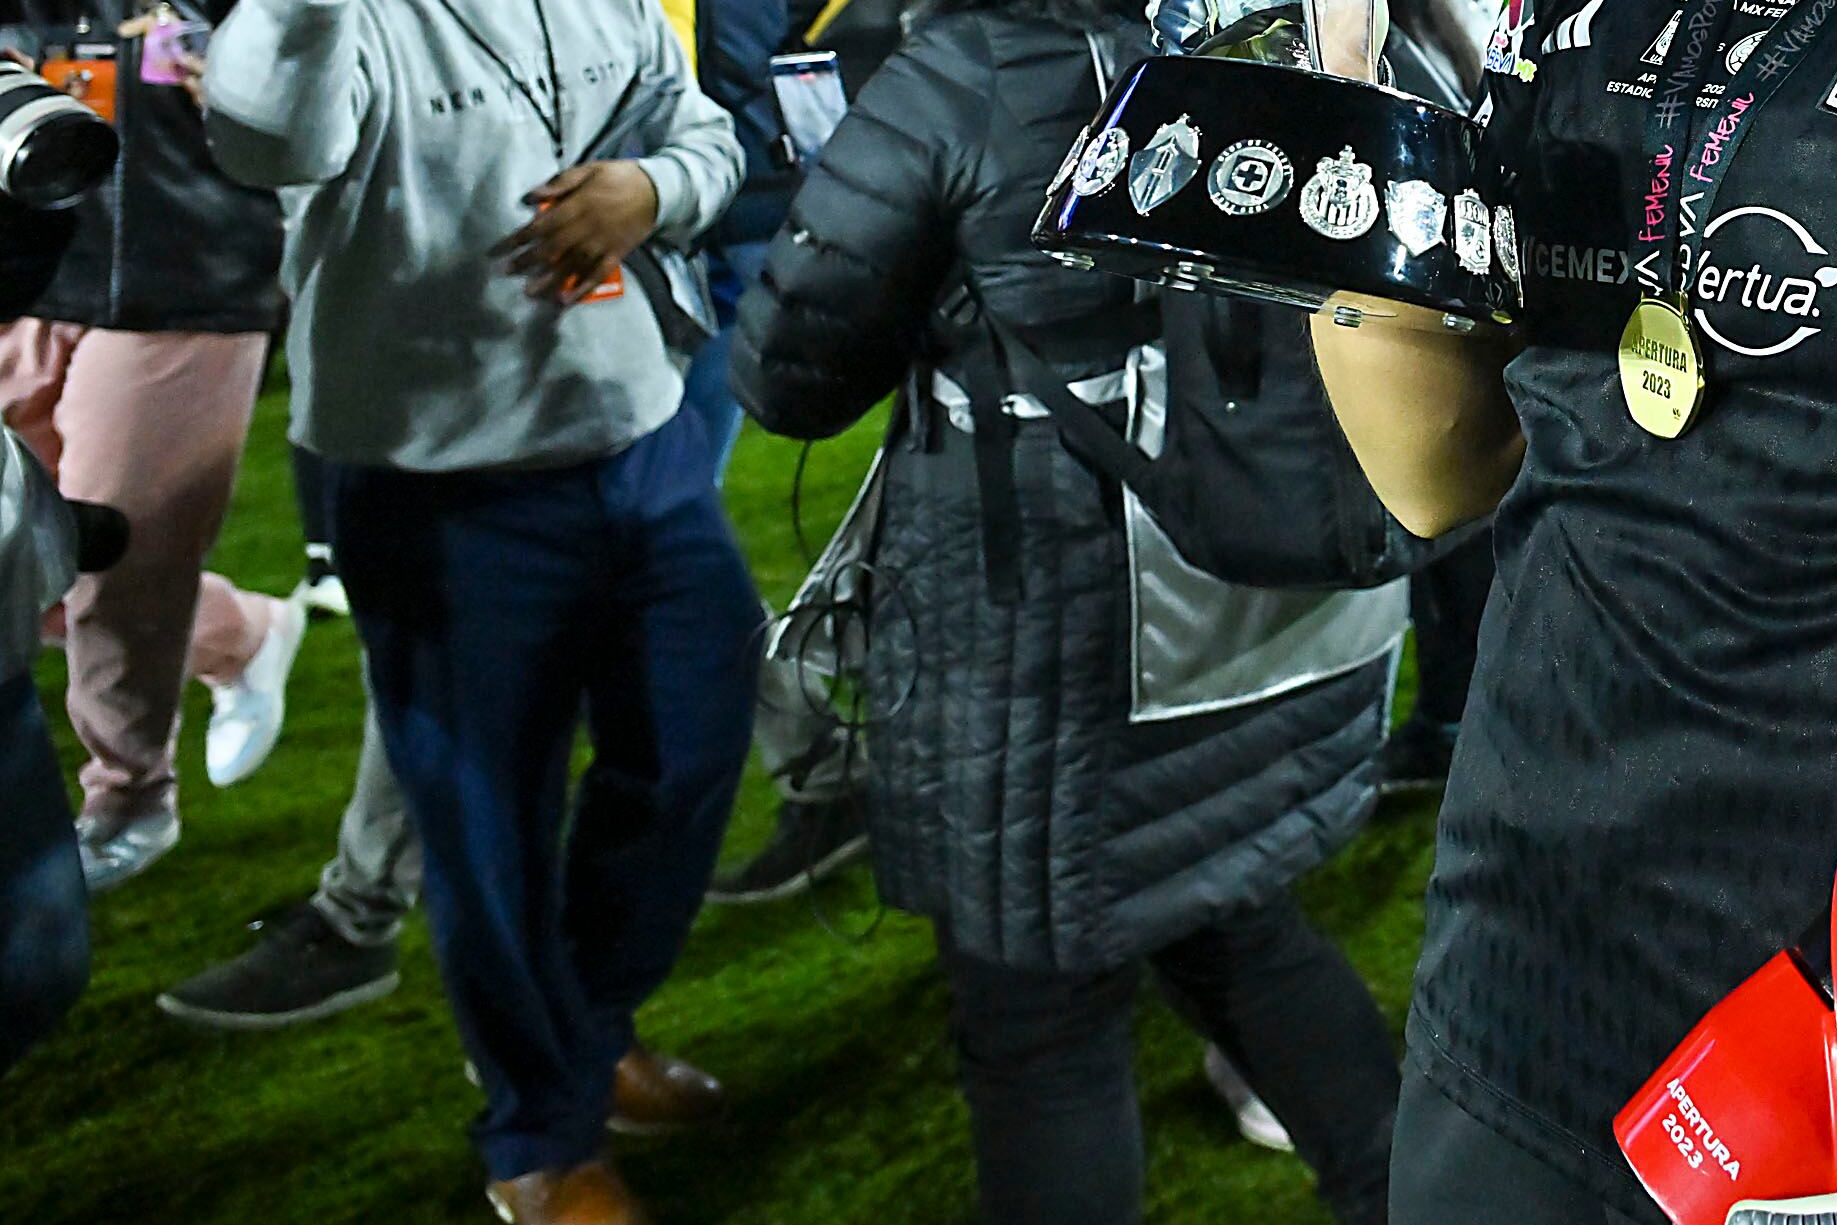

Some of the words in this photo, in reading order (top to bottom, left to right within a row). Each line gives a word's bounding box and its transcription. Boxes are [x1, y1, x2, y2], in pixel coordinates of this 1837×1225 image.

[1702, 83, 1726, 96] 202
[1631, 337, 1688, 373] APERTURA
[1642, 370, 1672, 400] 2023
[1661, 1113, 1704, 1169] 2023
[1666, 1078, 1741, 1182] APERTURA
